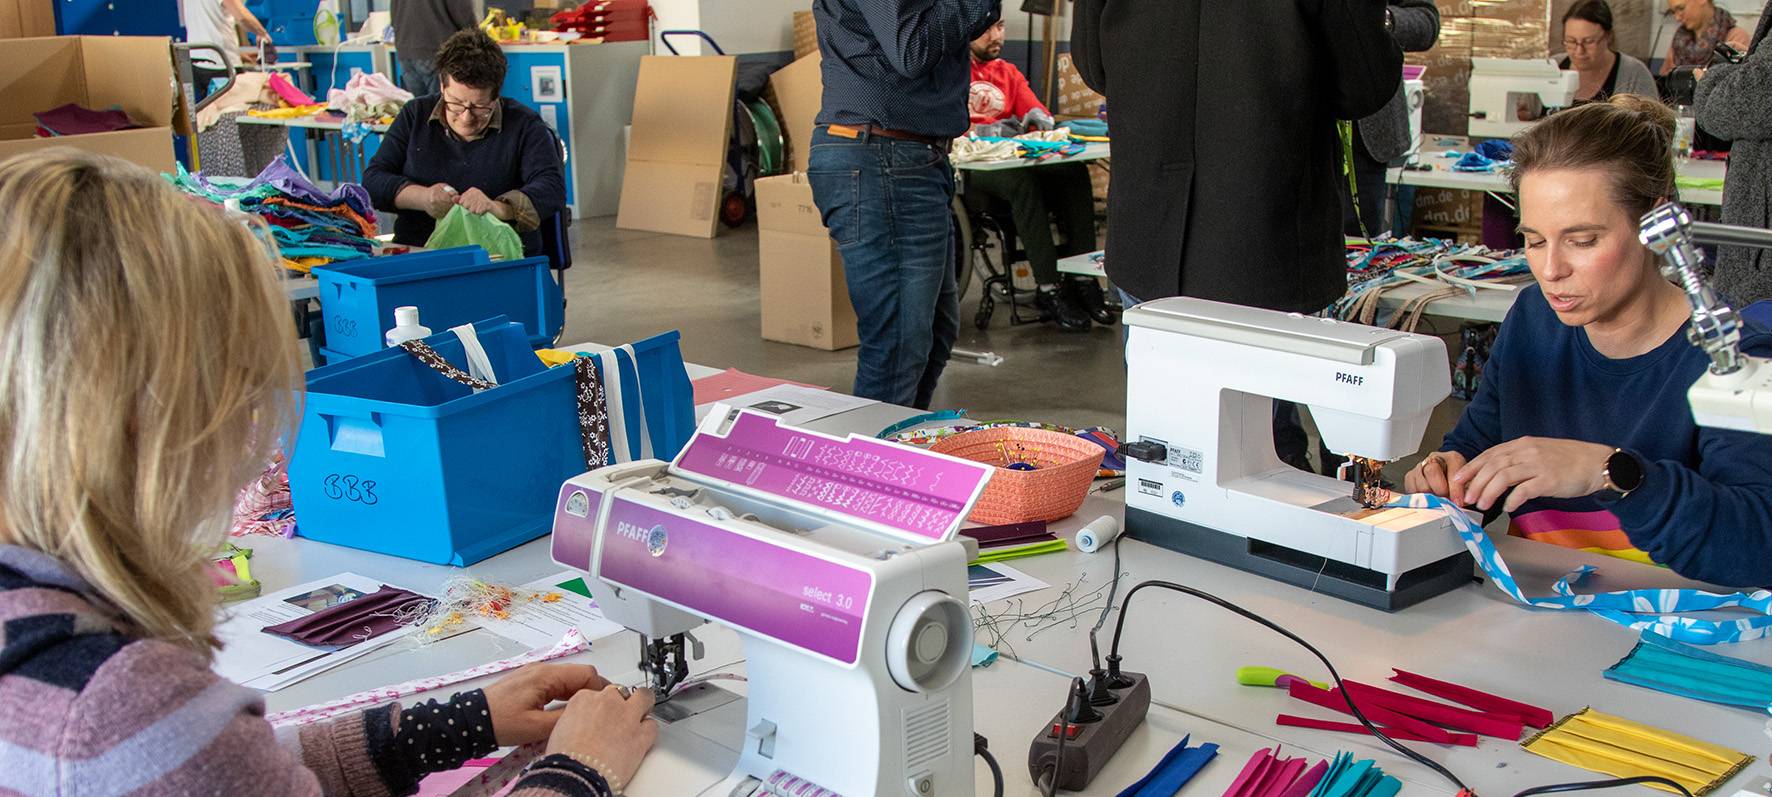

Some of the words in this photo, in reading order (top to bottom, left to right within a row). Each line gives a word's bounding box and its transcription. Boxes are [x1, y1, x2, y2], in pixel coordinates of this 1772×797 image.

[1416, 190, 1453, 208] dm.de
[1336, 371, 1364, 386] PFAFF
[324, 473, 378, 505] BBB
[617, 521, 649, 542] PFAFF
[802, 585, 832, 604] select
[836, 593, 853, 609] 3.0
